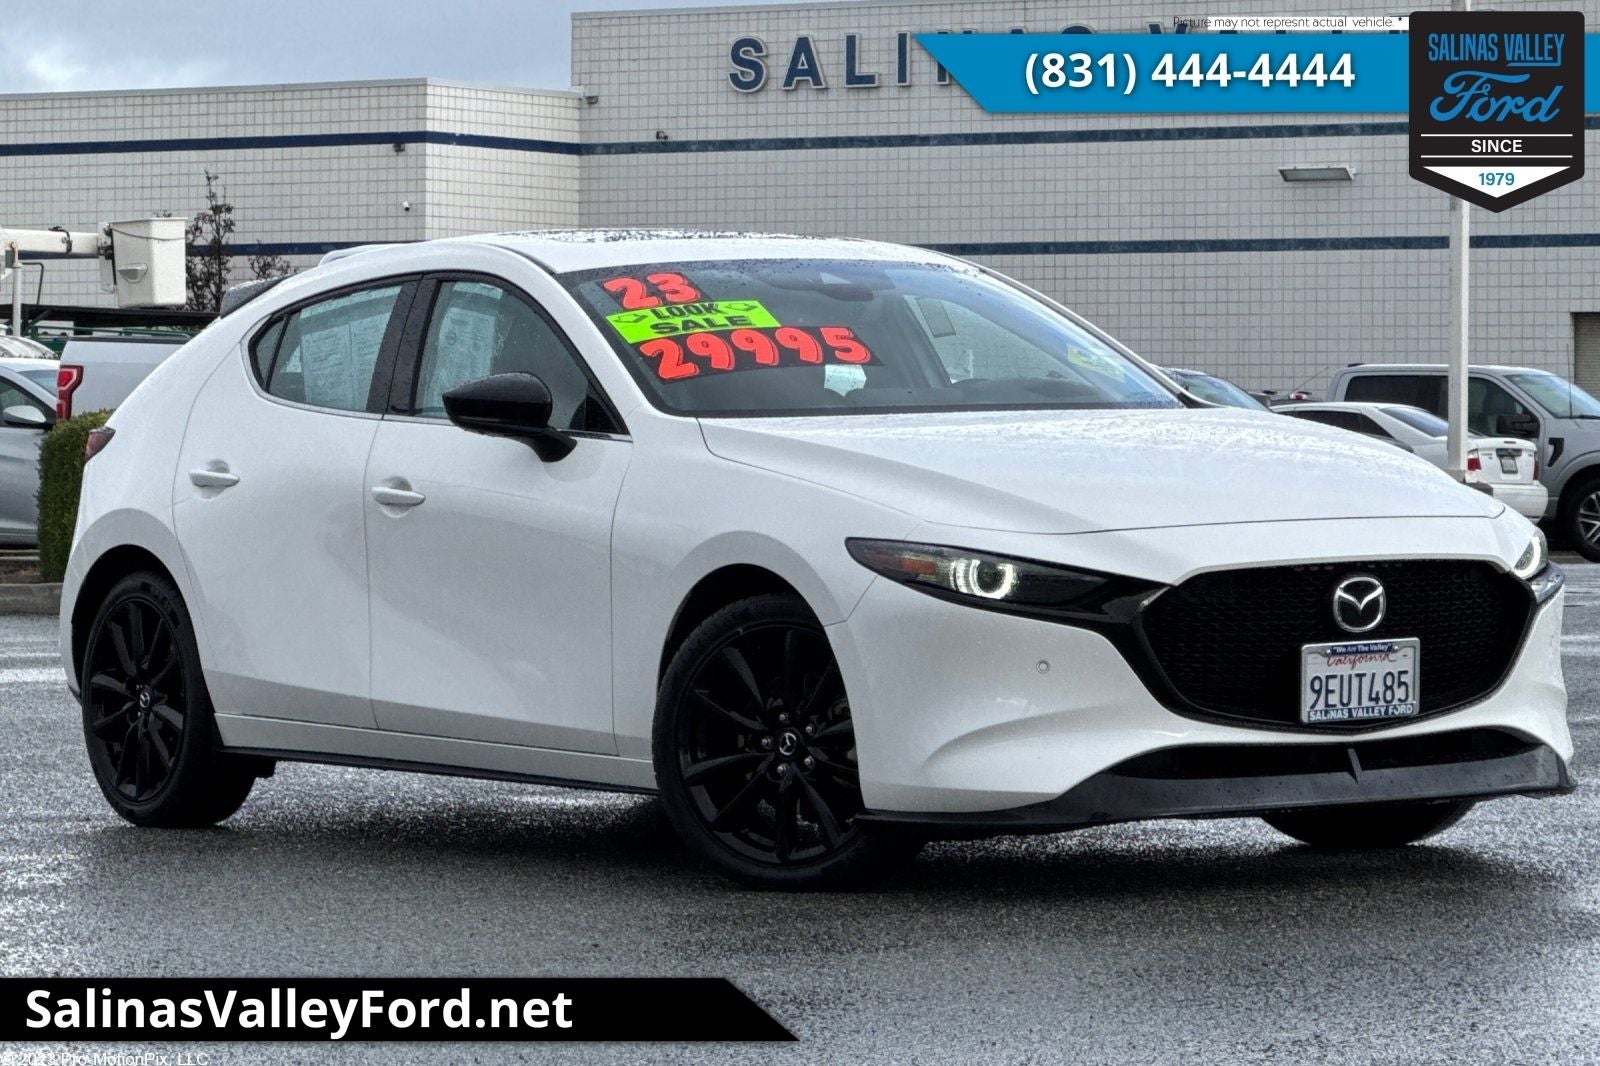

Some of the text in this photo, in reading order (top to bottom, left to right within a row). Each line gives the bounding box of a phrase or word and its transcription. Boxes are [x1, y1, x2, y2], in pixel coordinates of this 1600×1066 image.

[603, 272, 701, 309] 23
[650, 303, 724, 320] LOOK
[649, 315, 754, 334] SALE
[639, 326, 870, 380] 29995
[1327, 652, 1397, 671] California
[1309, 670, 1409, 710] 9EUT485
[1309, 704, 1413, 721] SALINAS VALLEY FORD
